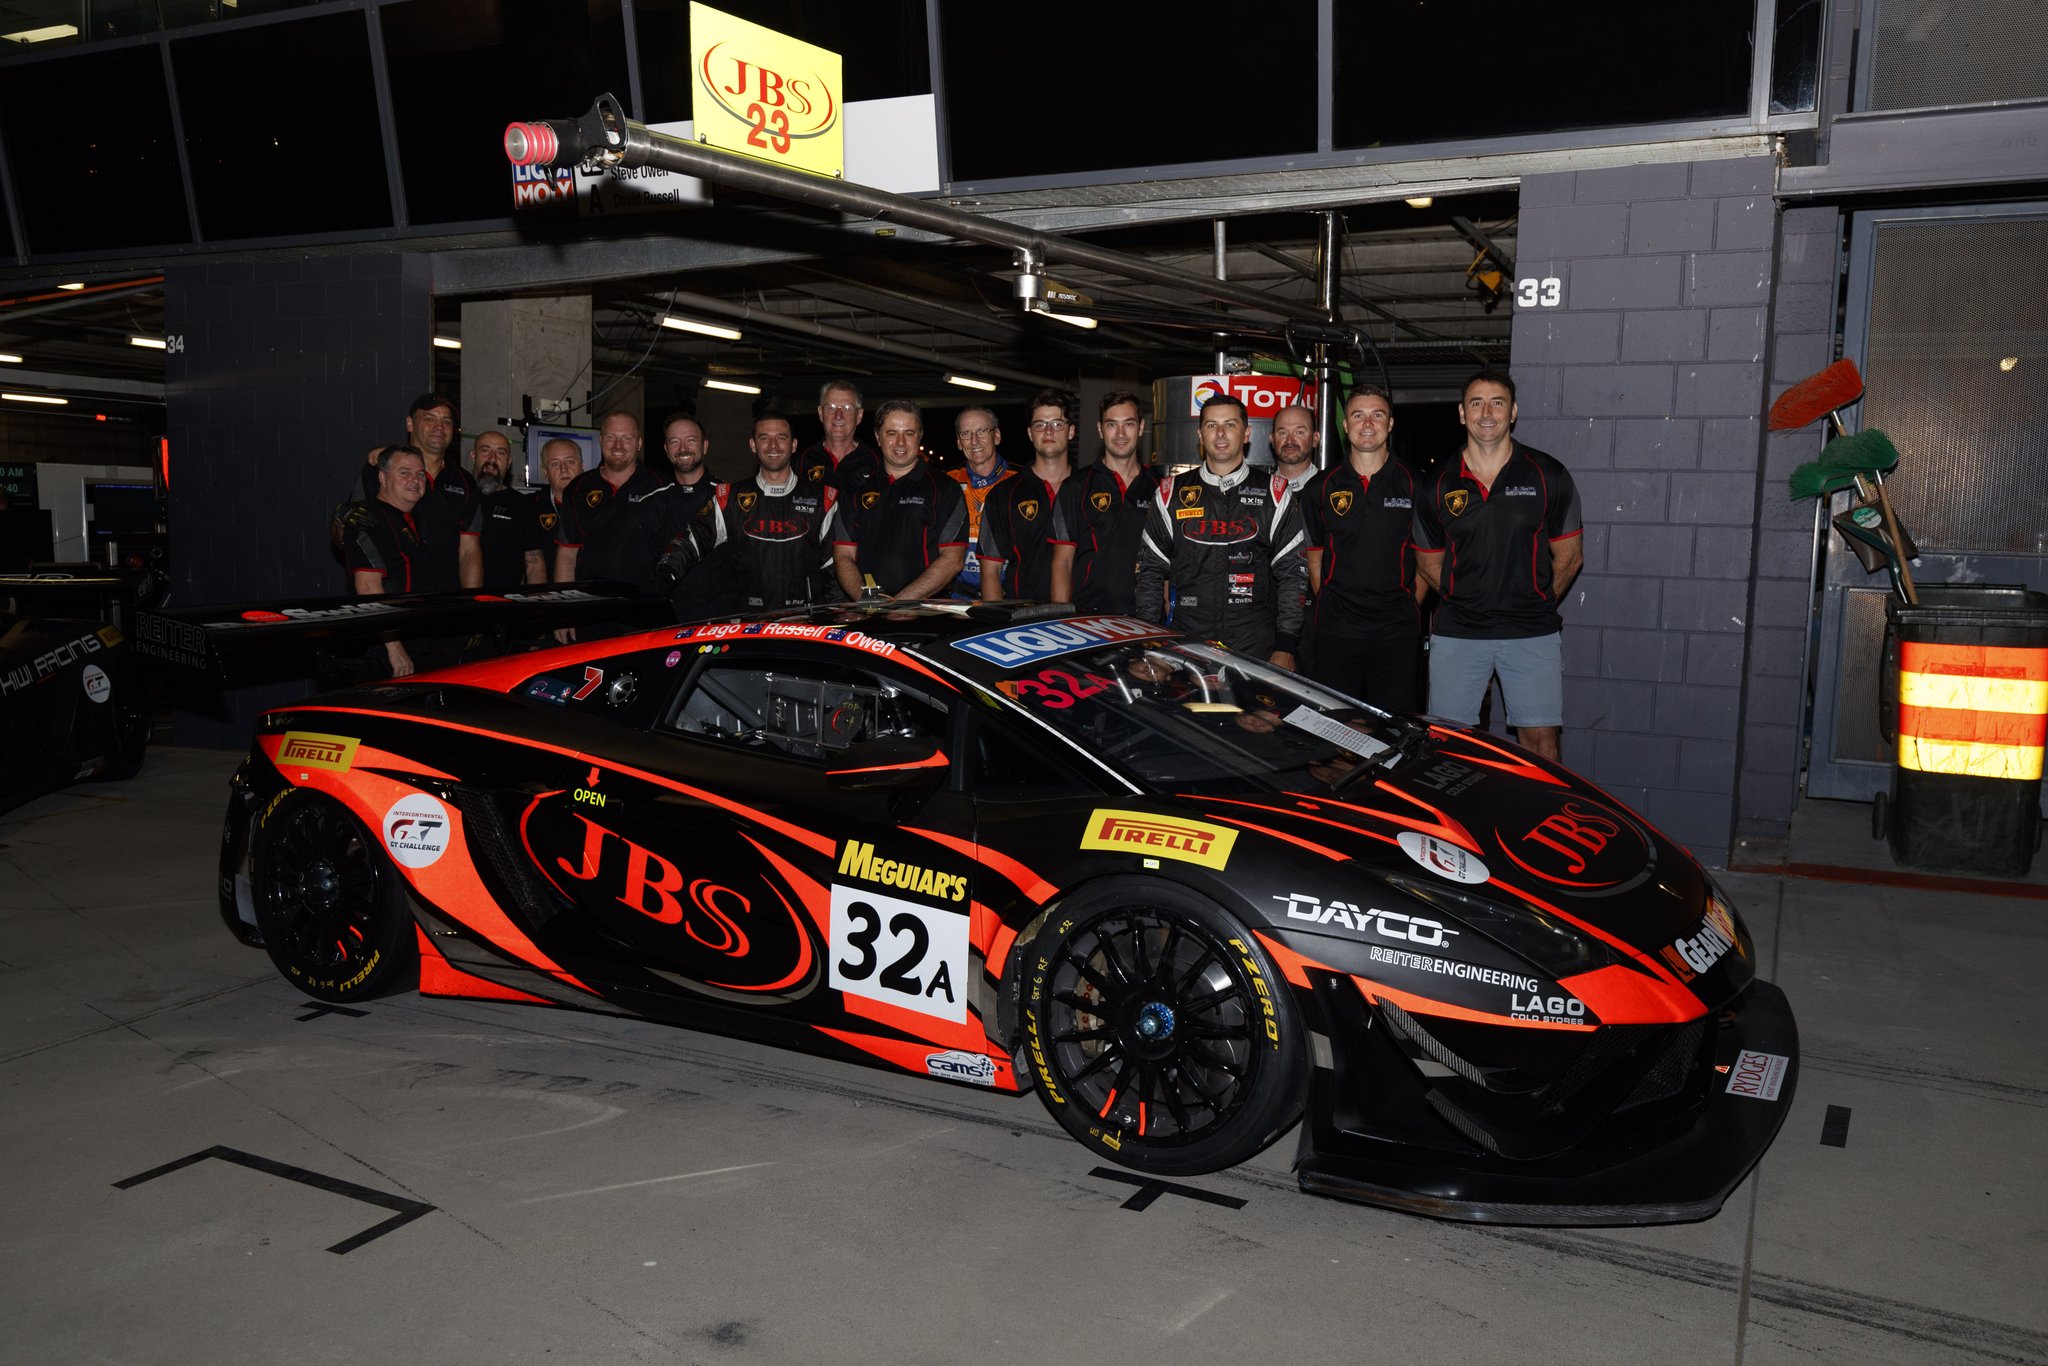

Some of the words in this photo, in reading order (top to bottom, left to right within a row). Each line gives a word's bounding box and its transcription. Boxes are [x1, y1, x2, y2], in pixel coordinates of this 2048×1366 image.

[725, 57, 812, 115] JBS
[747, 102, 792, 154] 23
[611, 166, 638, 181] Steve
[517, 181, 571, 206] MOLY
[614, 191, 641, 208] David
[643, 188, 680, 206] Russell
[1517, 278, 1561, 307] 33
[166, 335, 185, 354] 34
[8, 467, 24, 477] AM
[977, 479, 988, 488] 23
[754, 520, 798, 534] JBS
[1191, 520, 1245, 536] JBS
[136, 610, 208, 656] REITER
[696, 623, 741, 639] Lago
[763, 622, 827, 638] Russell
[845, 631, 896, 656] Owen
[966, 623, 1102, 664] LIQUI
[1070, 617, 1170, 640] MOLY
[34, 633, 103, 678] RACING
[135, 640, 208, 671] ENGINEERING
[283, 738, 346, 764] PIRELLI
[1412, 761, 1471, 791] LAGO
[573, 787, 606, 807] OPEN
[393, 811, 444, 820] INTERCONTINENTAL
[390, 841, 399, 849] GT
[399, 842, 441, 852] CHALLENGE
[1098, 817, 1216, 856] PIRELLI
[1521, 801, 1622, 875] JBS
[837, 839, 968, 902] MEGUIAR'S
[557, 811, 752, 959] JBS
[1282, 893, 1446, 947] DAYCO
[339, 948, 381, 992] PIRELLI
[1037, 956, 1049, 972] RF
[1511, 993, 1585, 1016] LAGO
[1511, 1012, 1538, 1022] COLD
[1543, 1015, 1585, 1026] STORES
[926, 1058, 984, 1077] cams
[1025, 1008, 1066, 1104] PIRELLI
[973, 1077, 990, 1085] sport
[1731, 1052, 1769, 1095] RYDGES
